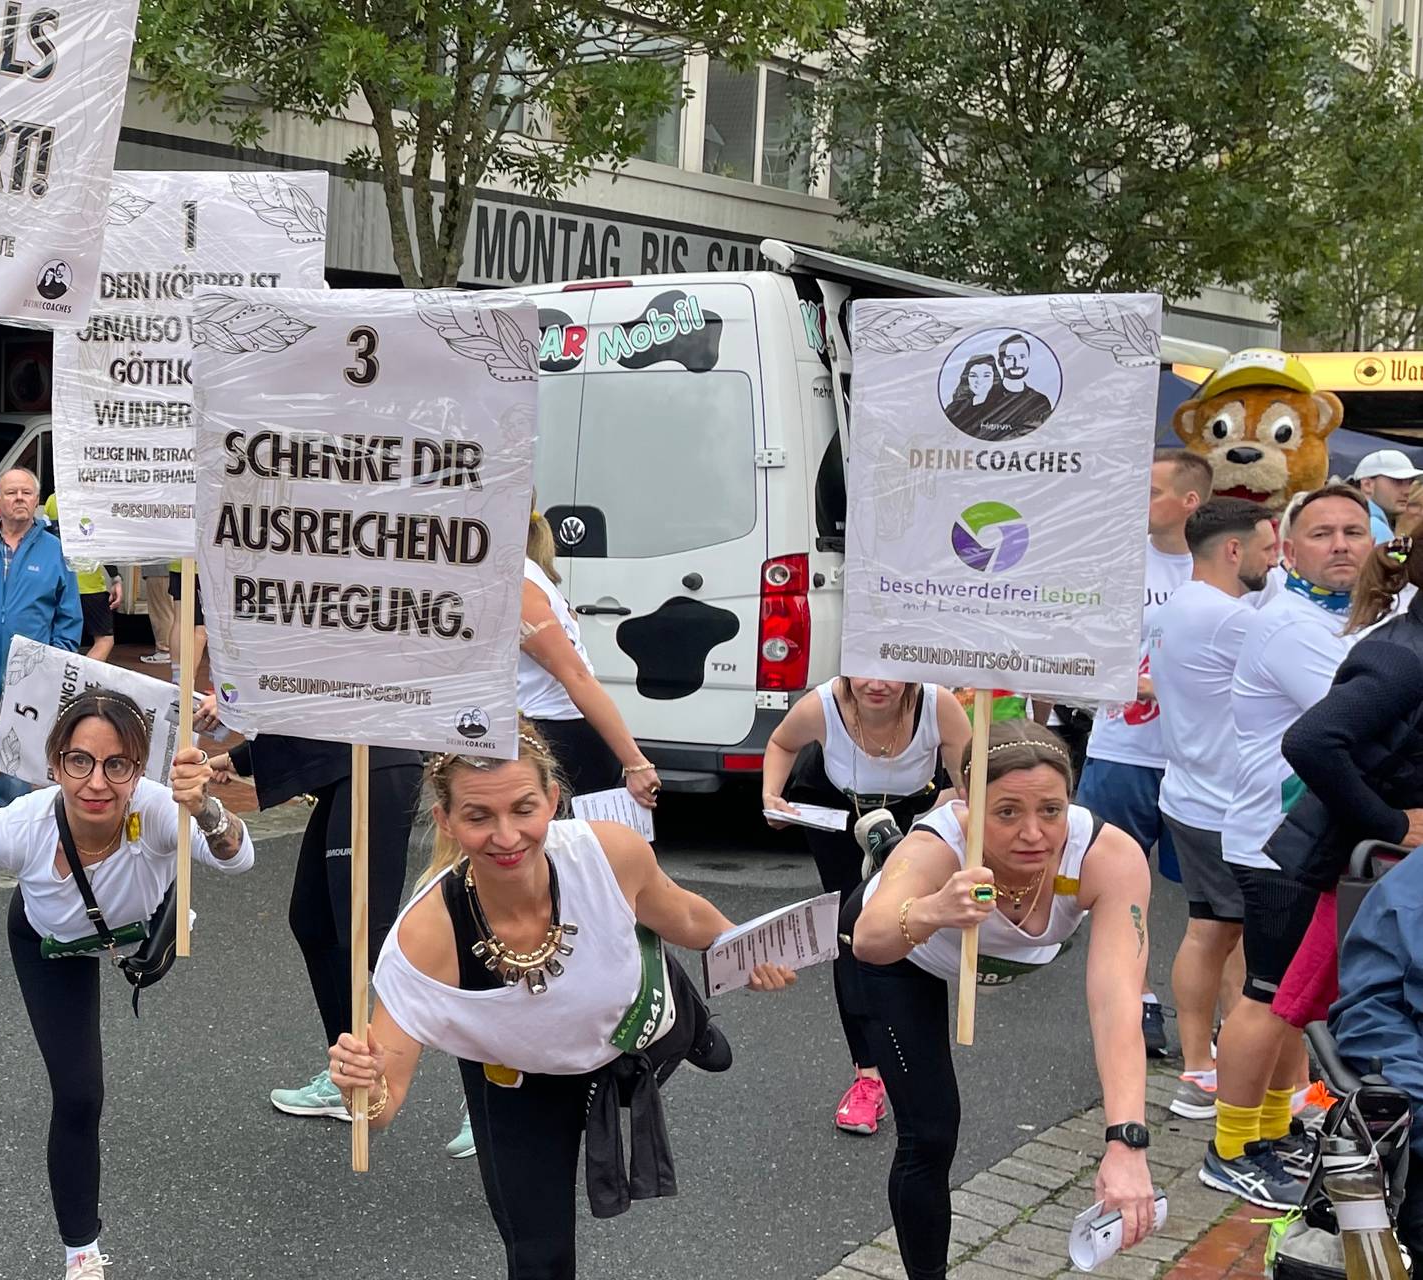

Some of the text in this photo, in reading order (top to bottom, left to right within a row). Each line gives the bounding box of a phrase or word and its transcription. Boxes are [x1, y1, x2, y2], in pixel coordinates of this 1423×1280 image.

[182, 200, 198, 251] 1
[474, 206, 621, 284] MONTAG
[100, 272, 151, 299] DEIN
[343, 324, 381, 388] 3
[598, 295, 705, 366] Mobil
[125, 469, 151, 483] UND
[222, 429, 485, 492] SCHENKE DIR
[908, 448, 1082, 473] DEINECOACHES
[214, 502, 491, 567] AUSREICHEND
[233, 574, 476, 642] BEWEGUNG.
[880, 576, 1102, 606] beschwerdefreileben
[258, 674, 432, 706] #GESUNDHEITSGEBOTE
[711, 662, 737, 672] TDI
[15, 702, 39, 721] 5
[636, 988, 663, 1050] 6841
